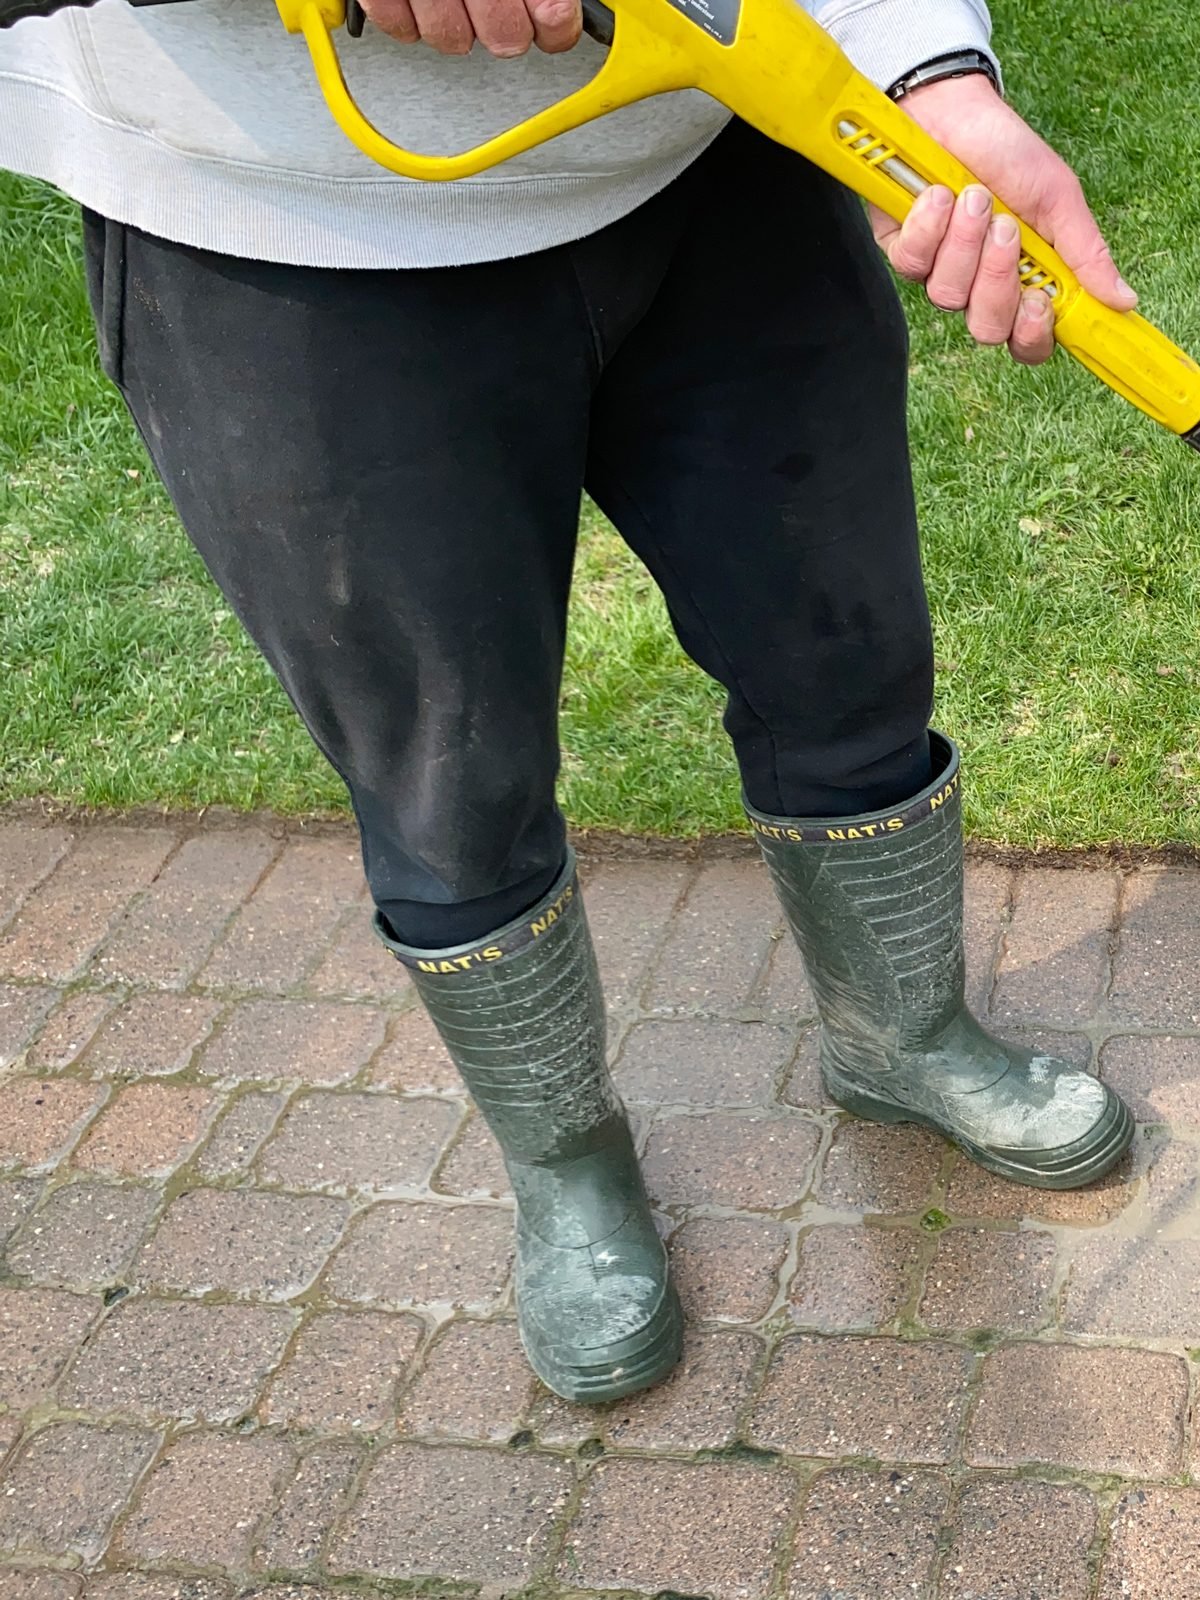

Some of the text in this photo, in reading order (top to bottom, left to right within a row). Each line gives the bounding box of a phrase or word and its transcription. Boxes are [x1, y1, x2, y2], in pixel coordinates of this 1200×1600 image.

[827, 818, 905, 840] NAT'S
[530, 887, 573, 937] NAT'S
[418, 947, 503, 973] NAT'S
